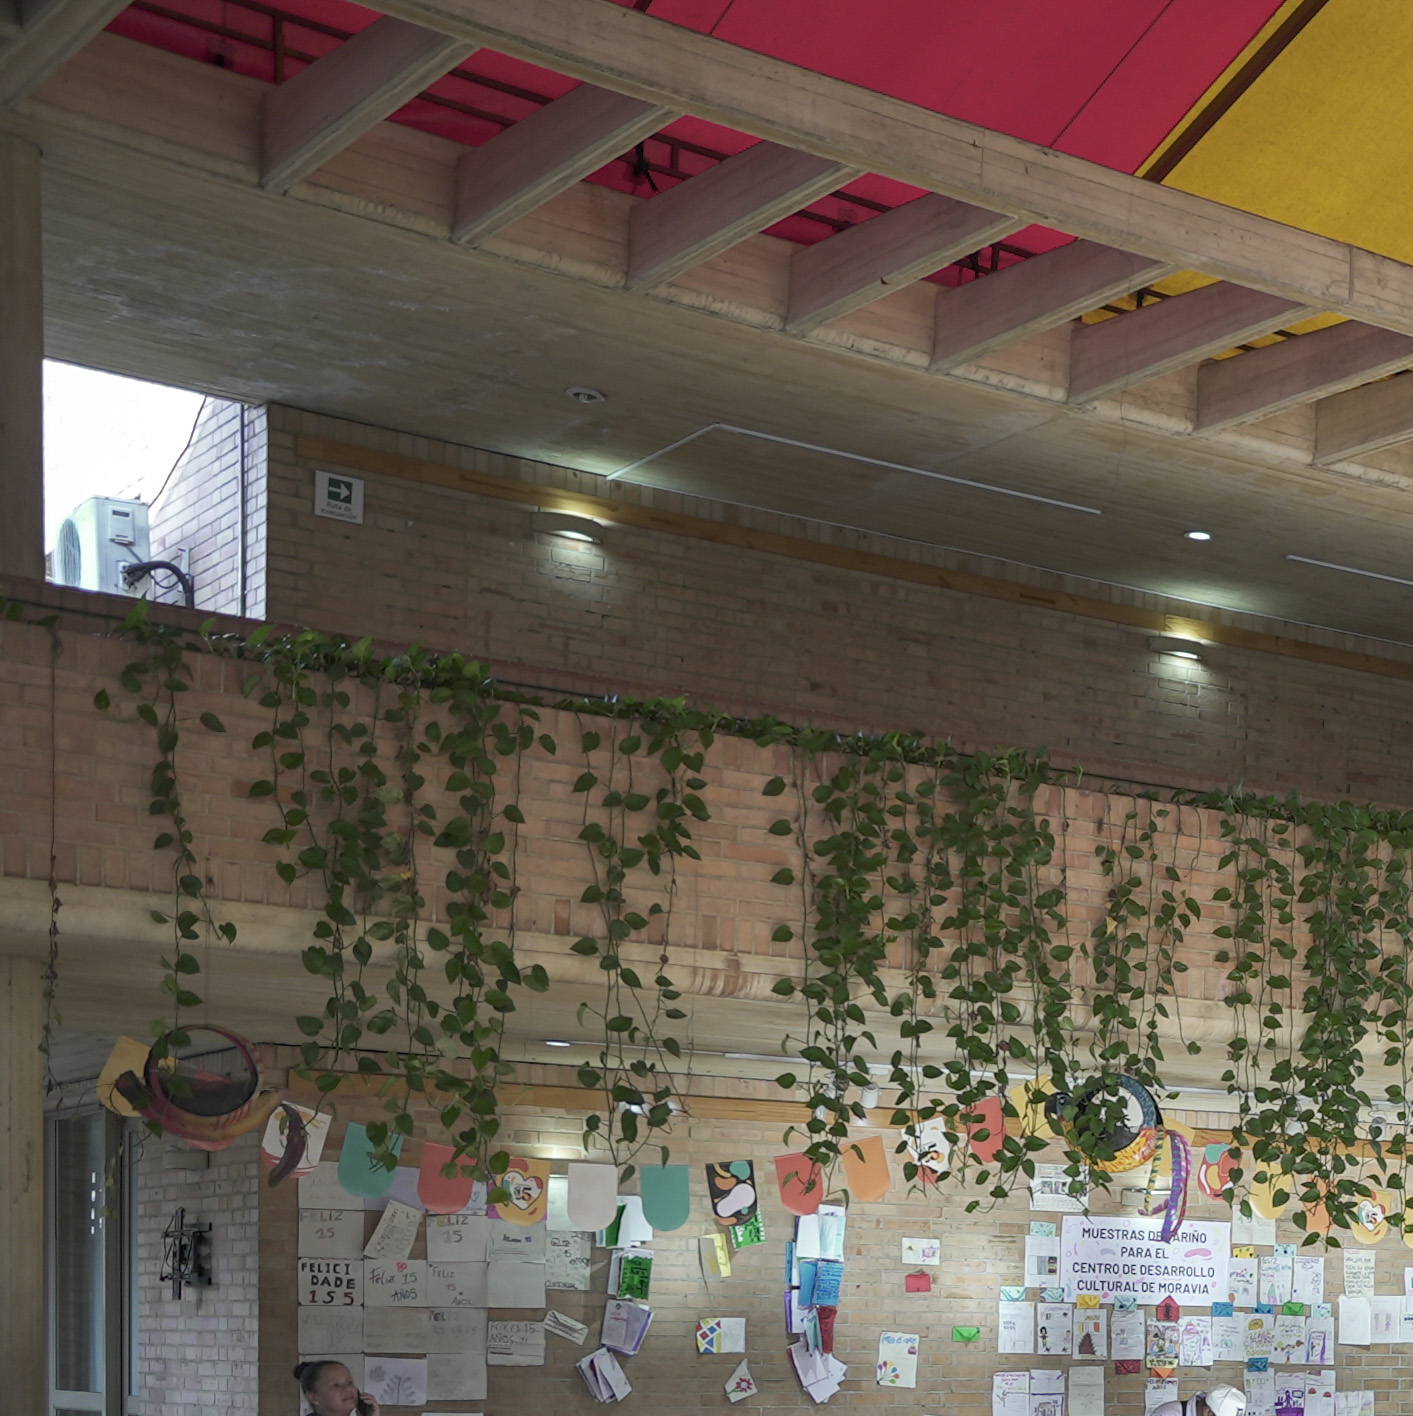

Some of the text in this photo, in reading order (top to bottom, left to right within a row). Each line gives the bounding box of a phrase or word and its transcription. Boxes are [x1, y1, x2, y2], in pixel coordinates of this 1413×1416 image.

[1082, 1228, 1145, 1241] MUESTRAS
[1170, 1229, 1207, 1244] ARIÑO
[1121, 1247, 1169, 1260] PARA EL
[301, 1263, 351, 1275] FELICI
[1072, 1262, 1120, 1275] CENTRO
[1123, 1264, 1136, 1275] DE
[1140, 1265, 1215, 1278] DESARROLLO
[311, 1275, 356, 1289] DADE
[1077, 1279, 1210, 1295] CULTURAL DE MORAVIA
